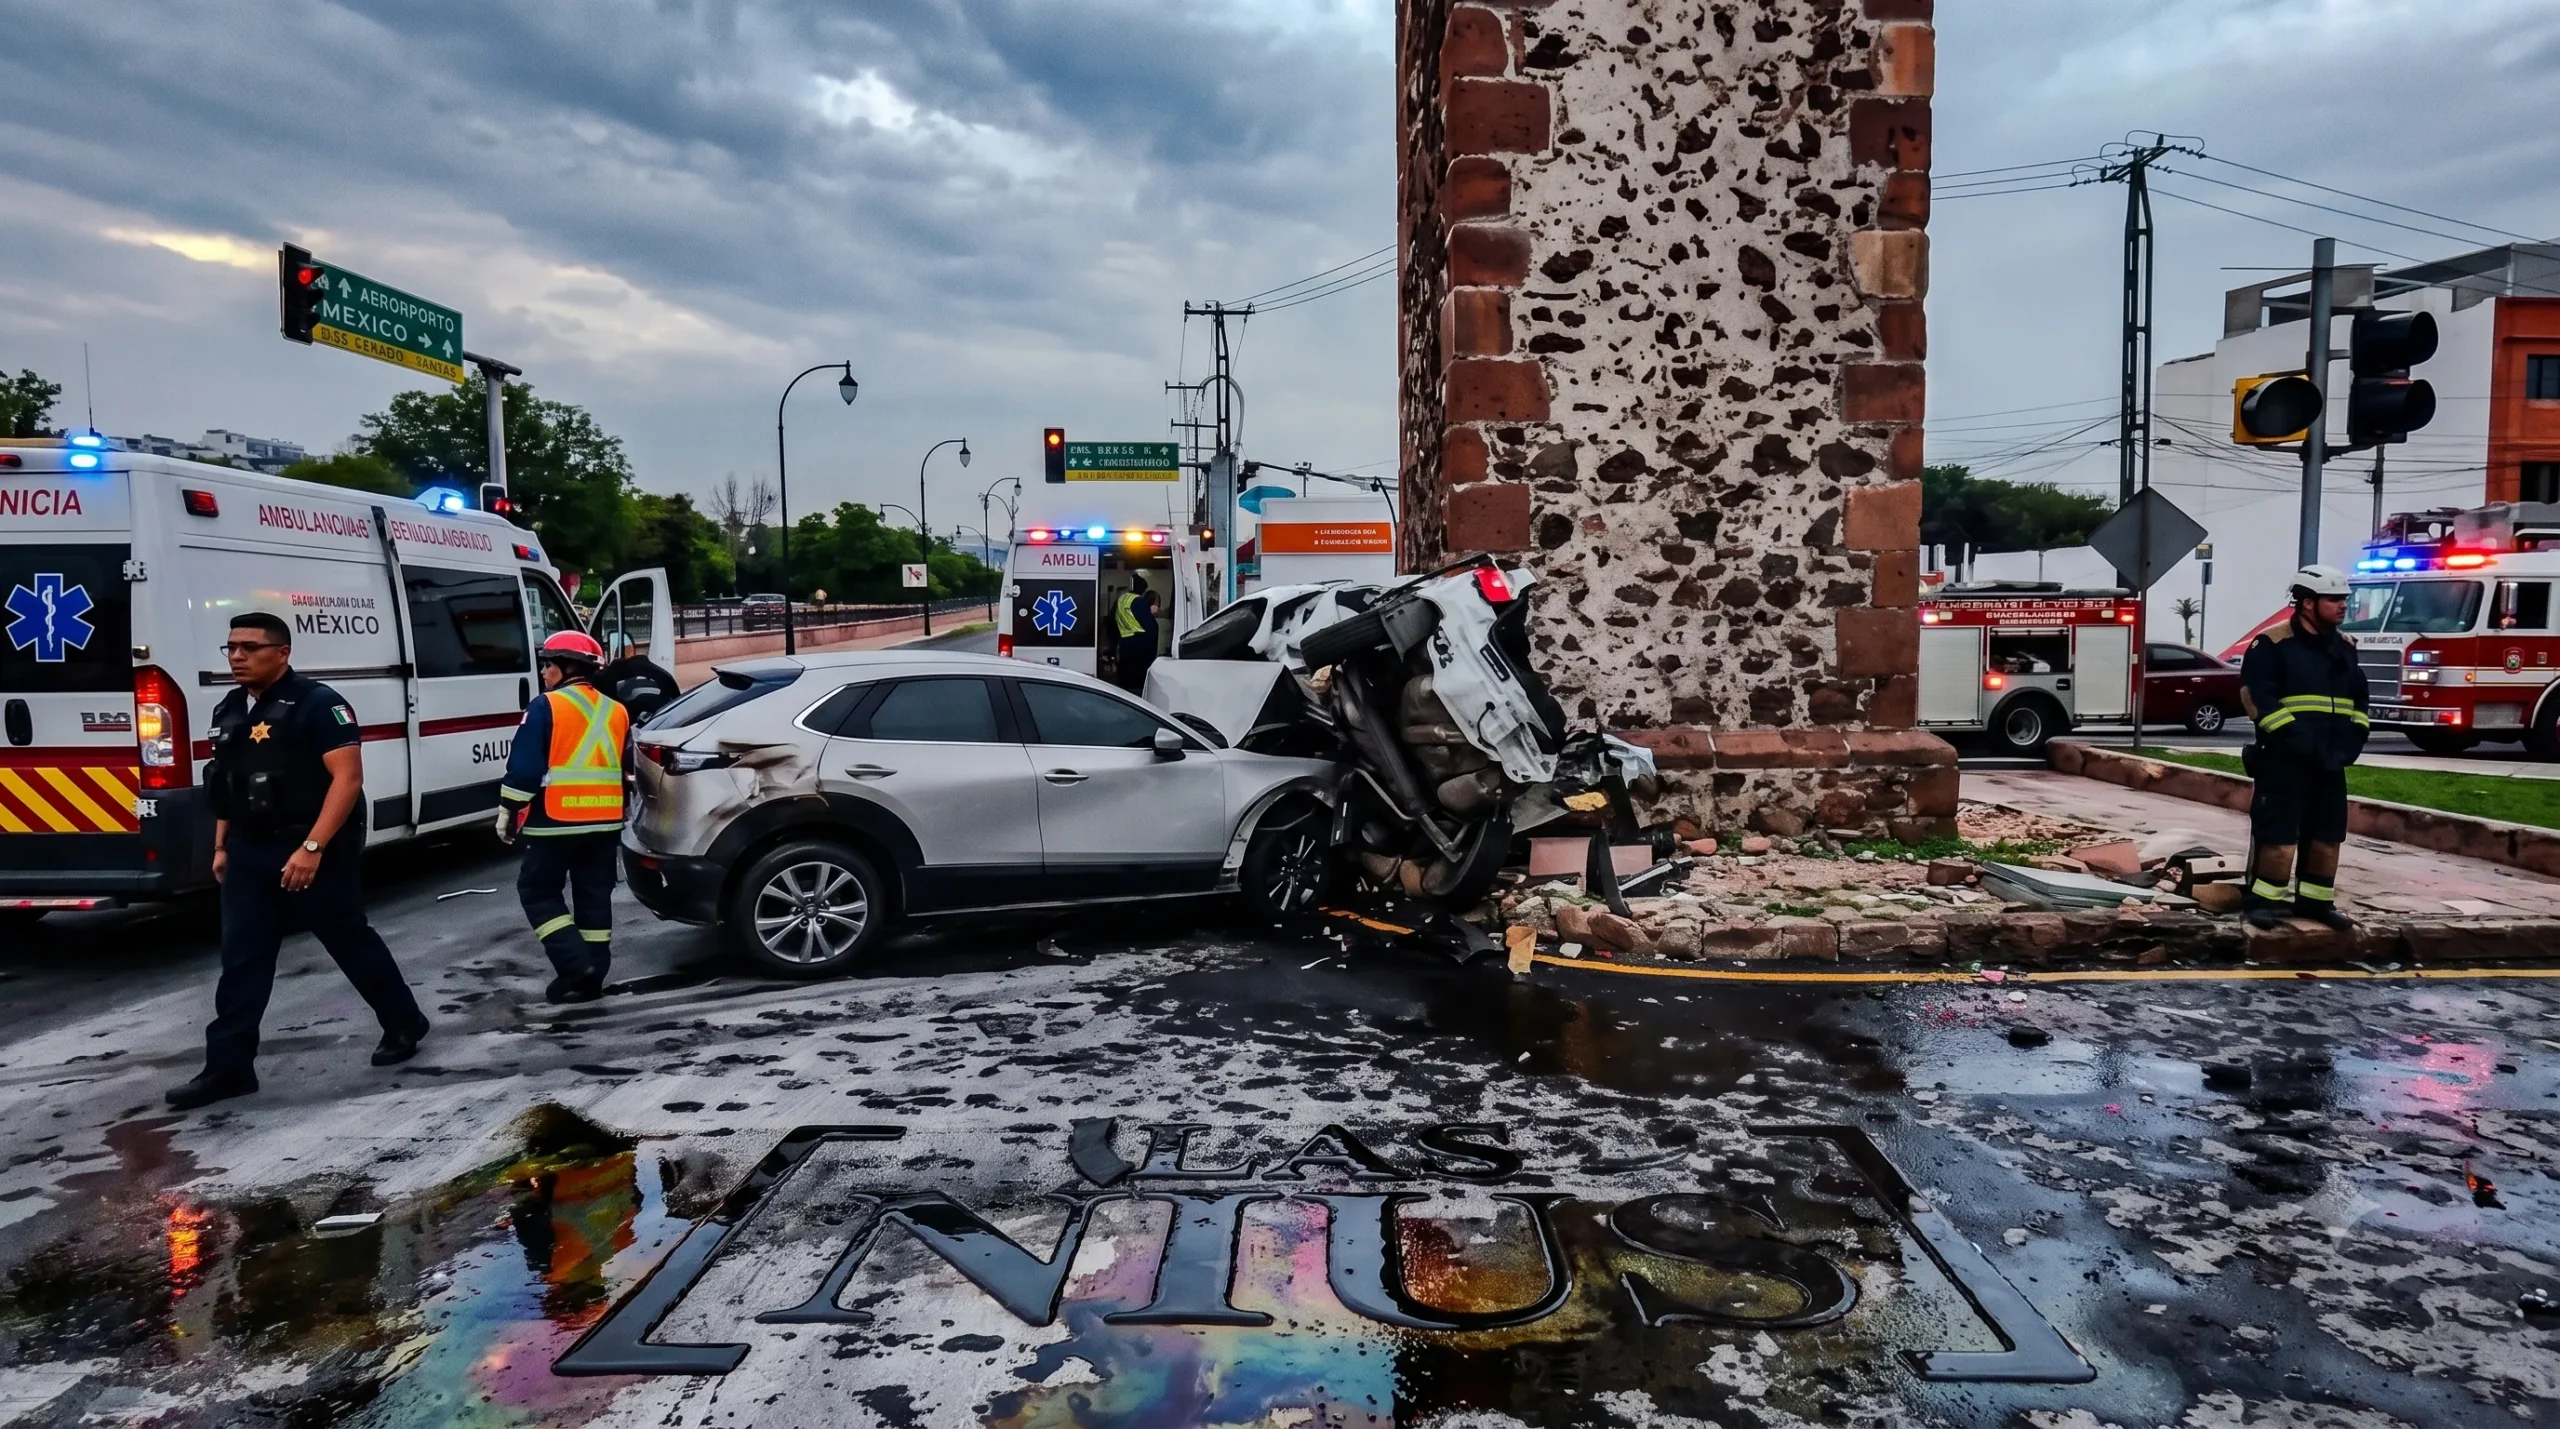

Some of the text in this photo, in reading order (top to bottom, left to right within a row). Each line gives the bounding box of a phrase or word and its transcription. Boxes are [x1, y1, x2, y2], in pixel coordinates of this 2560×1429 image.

[322, 300, 408, 342] MEXICO
[360, 287, 454, 334] AERORPORTO
[0, 489, 82, 516] NICIA
[1041, 553, 1097, 567] AMBUL
[472, 739, 512, 764] SALU
